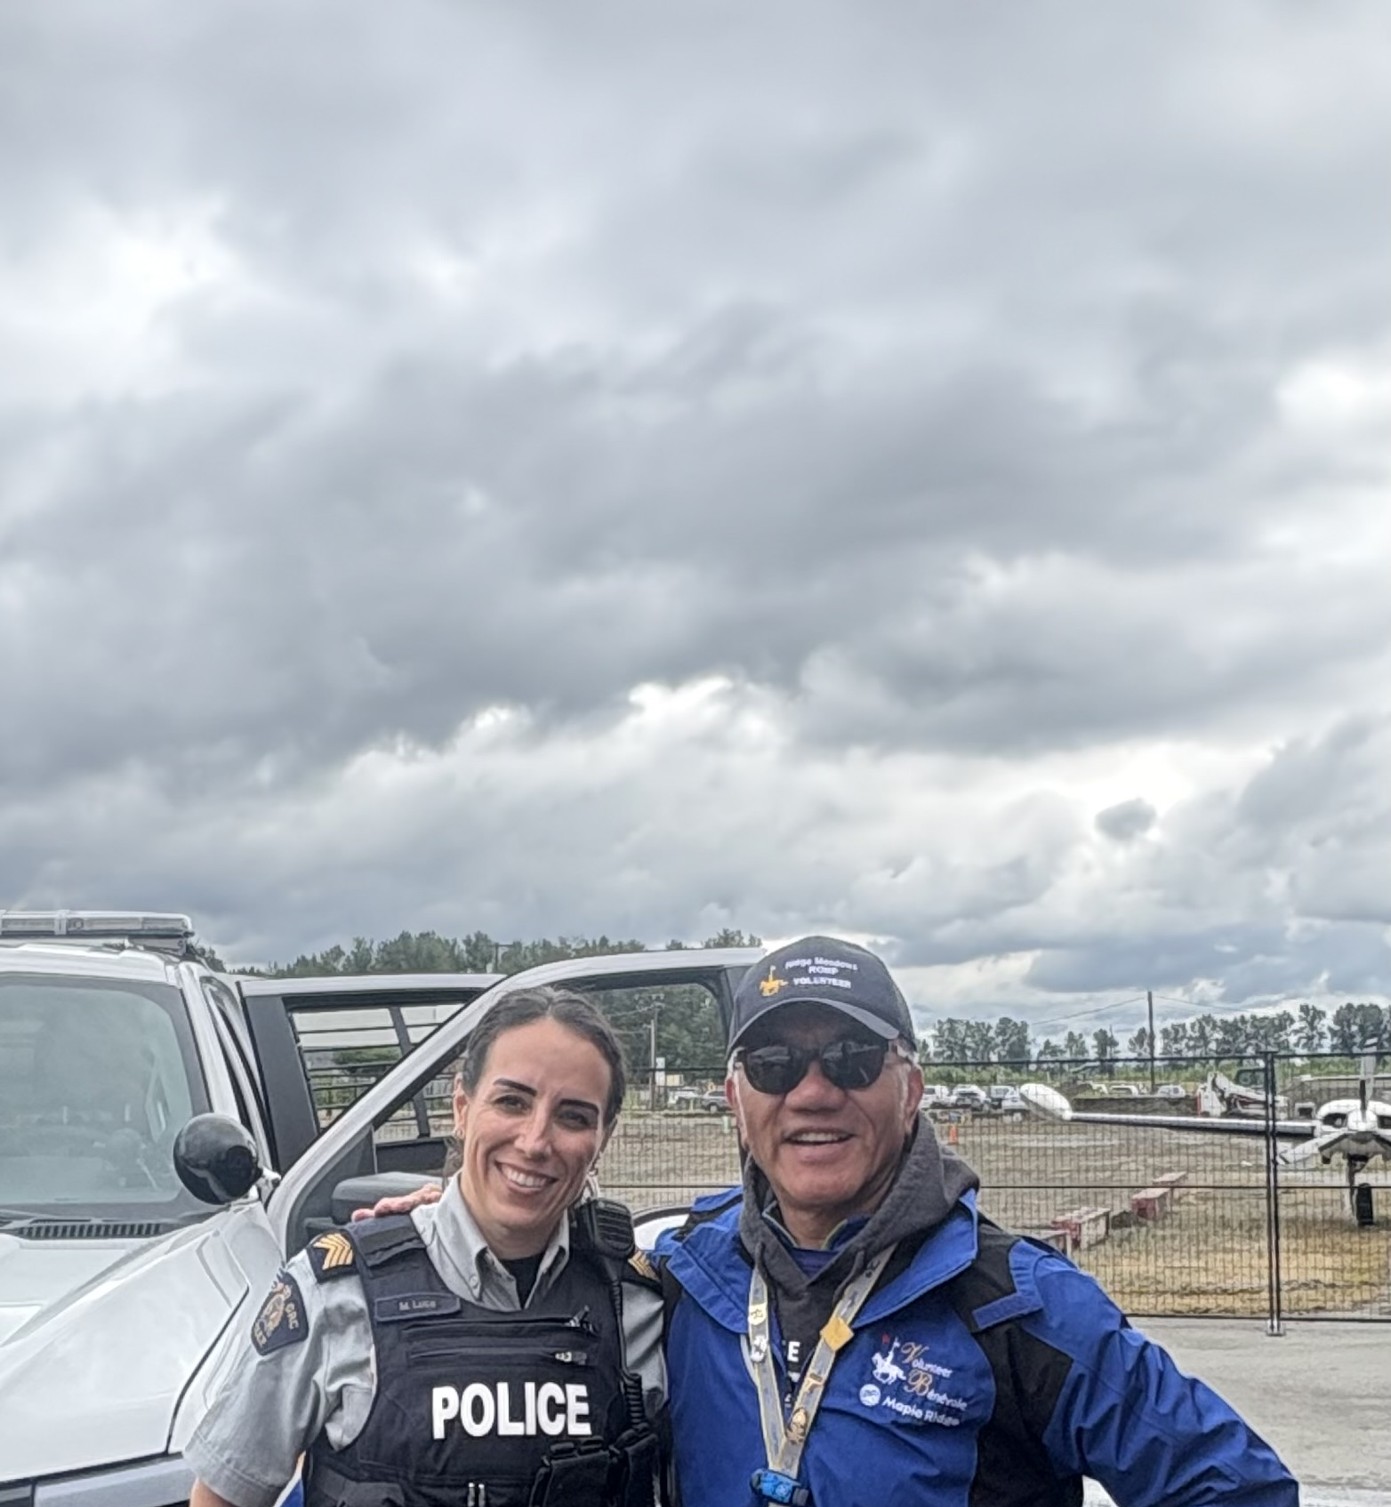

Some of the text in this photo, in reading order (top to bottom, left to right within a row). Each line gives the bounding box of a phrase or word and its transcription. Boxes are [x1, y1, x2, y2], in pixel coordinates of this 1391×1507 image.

[793, 977, 852, 989] VOLUNTEER
[285, 1302, 299, 1330] GRC
[901, 1342, 953, 1378] Volunteer
[432, 1381, 593, 1440] POLICE
[882, 1396, 960, 1427] Maple Ridge
